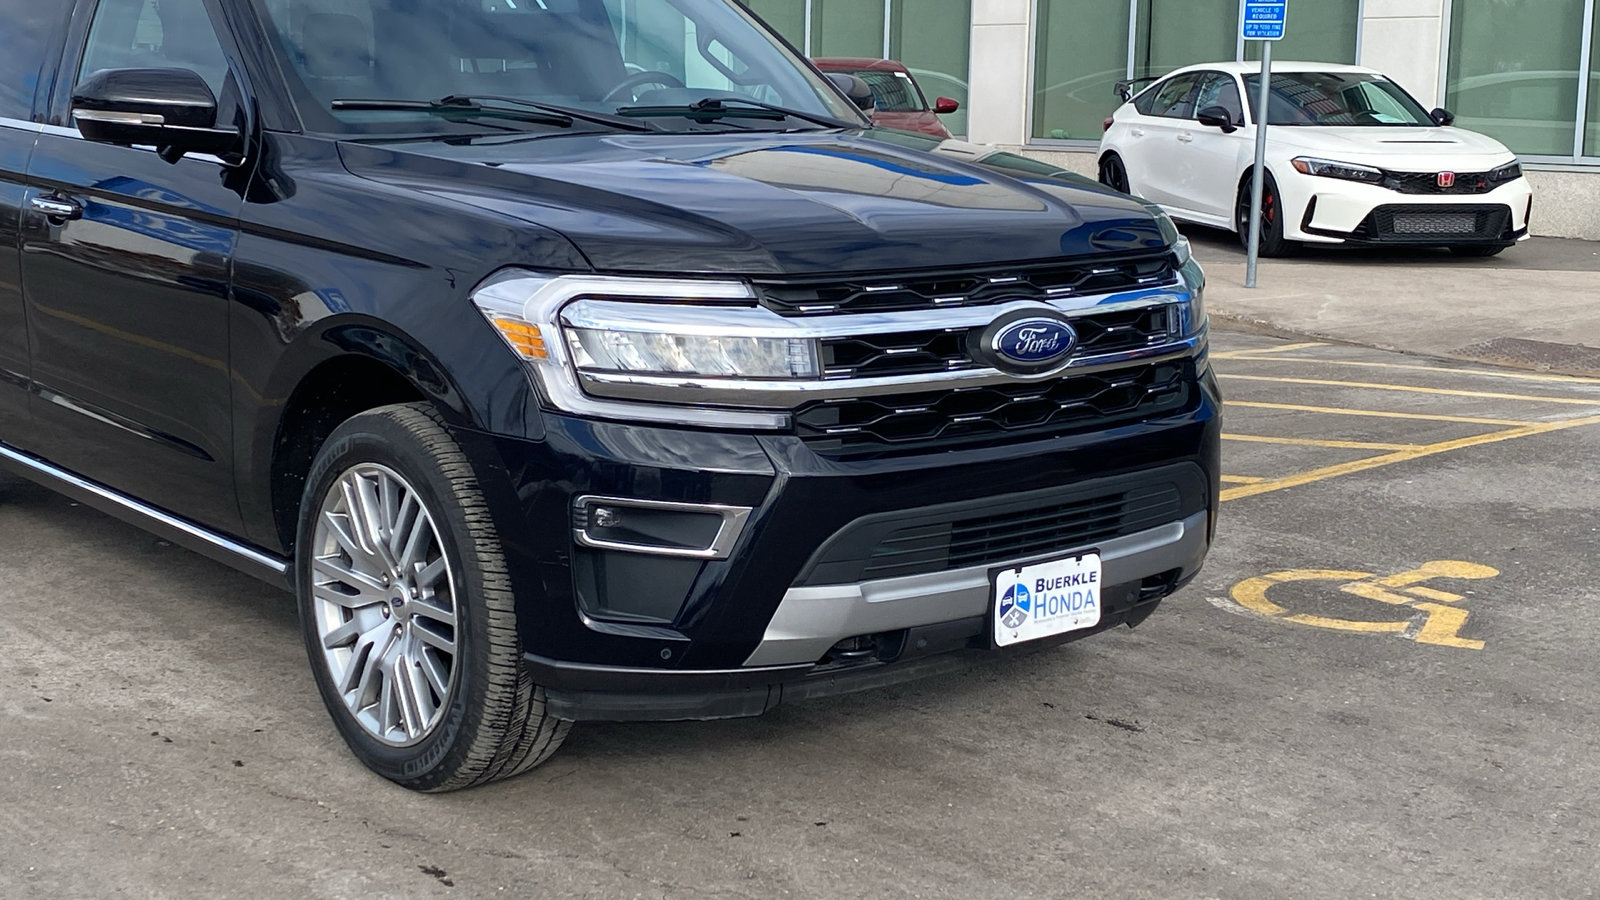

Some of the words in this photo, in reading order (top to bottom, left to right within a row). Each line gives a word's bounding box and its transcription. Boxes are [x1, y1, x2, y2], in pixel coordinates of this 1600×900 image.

[1015, 327, 1060, 355] Ford
[1035, 571, 1097, 593] BUERKLE
[1034, 589, 1096, 619] HONDA
